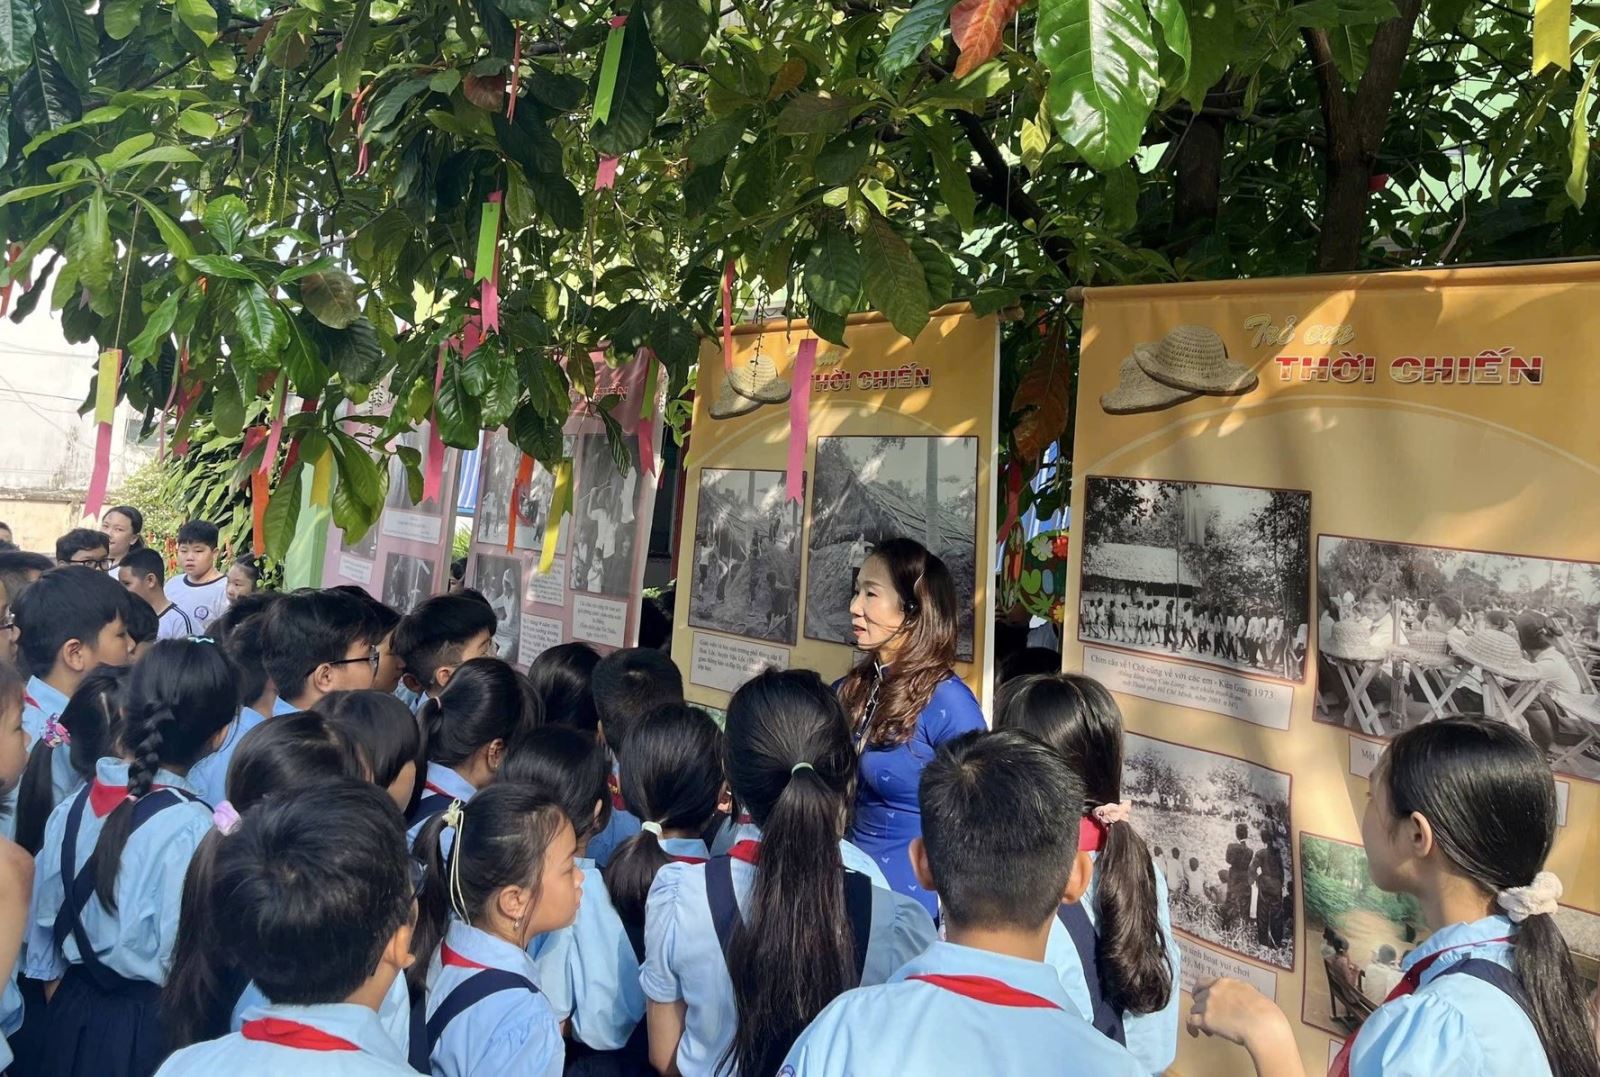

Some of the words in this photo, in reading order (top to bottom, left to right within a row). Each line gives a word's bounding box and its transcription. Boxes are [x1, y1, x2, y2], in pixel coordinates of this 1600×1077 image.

[1303, 324, 1355, 346] em
[810, 367, 852, 392] HỜI
[857, 361, 932, 390] CHIẾN
[1274, 351, 1376, 384] THỜI
[1390, 346, 1544, 384] CHIẾN
[1254, 688, 1274, 700] 1973
